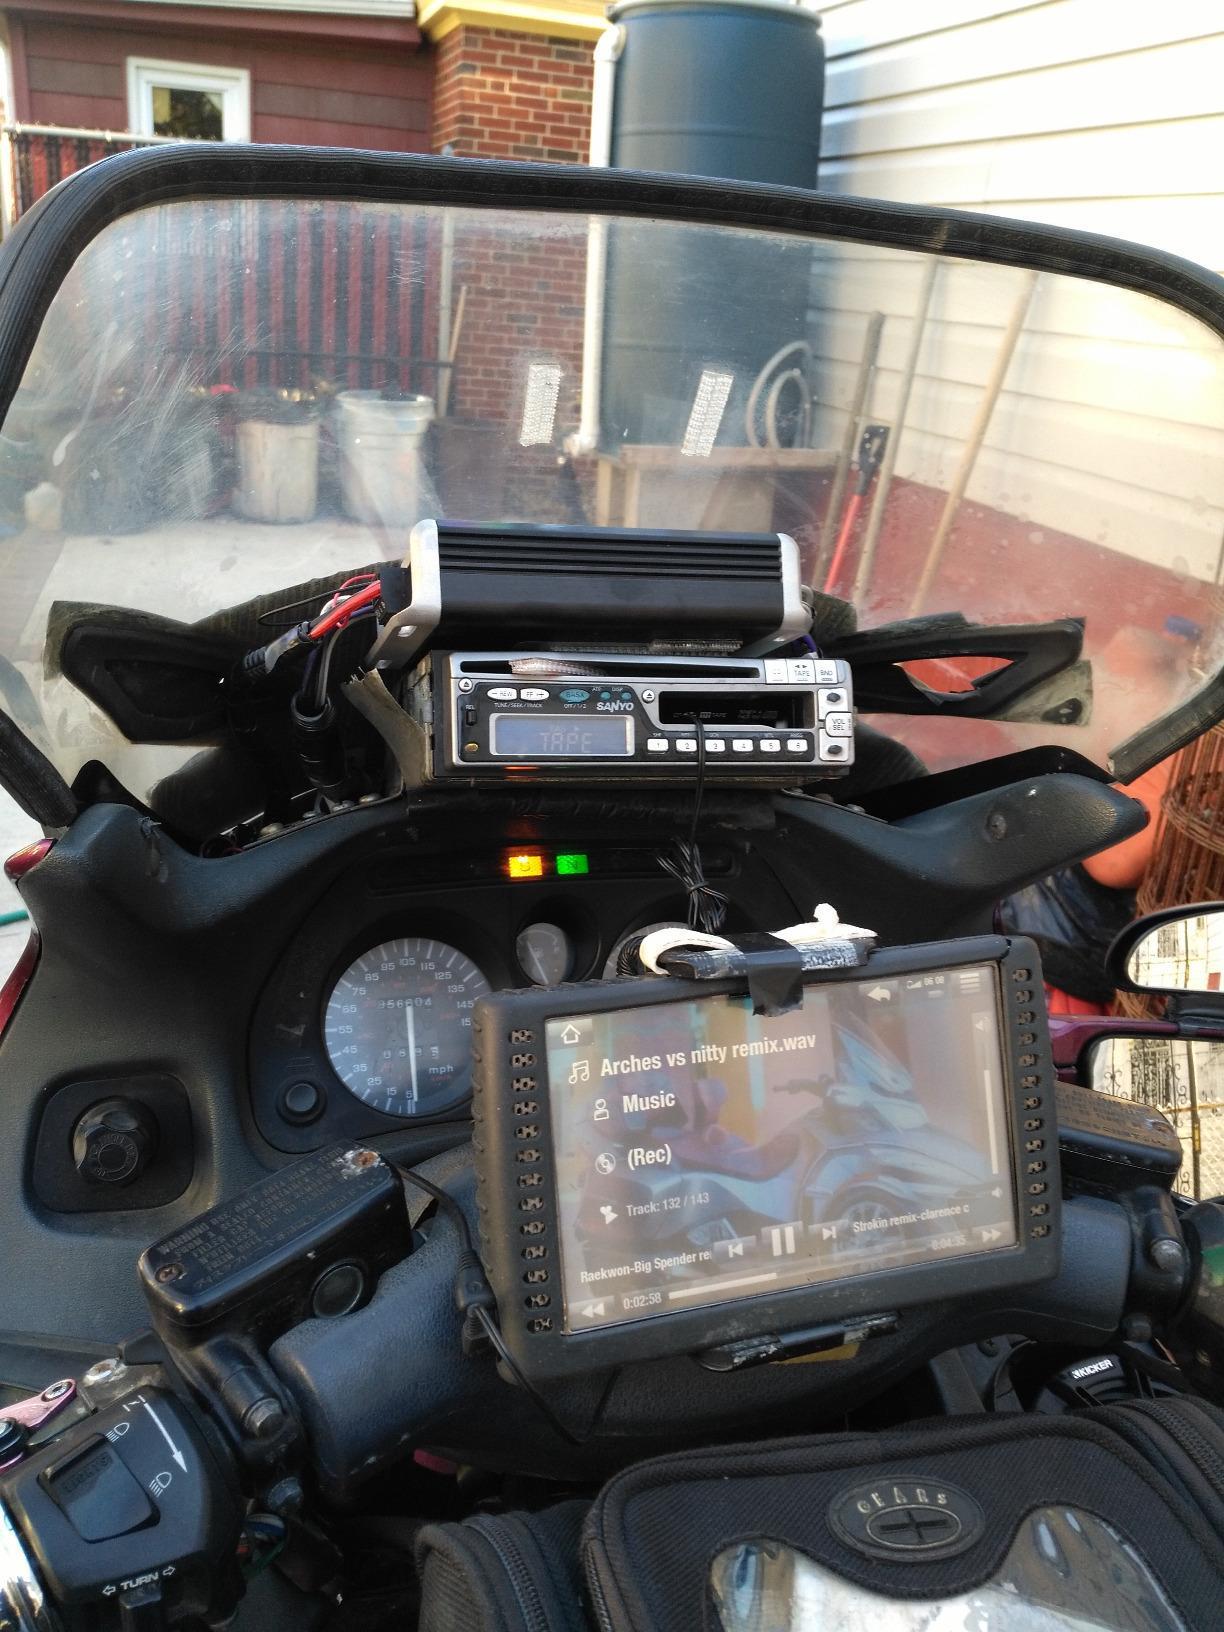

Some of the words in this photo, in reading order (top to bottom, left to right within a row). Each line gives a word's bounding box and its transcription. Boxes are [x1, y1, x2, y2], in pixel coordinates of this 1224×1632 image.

[596, 700, 634, 712] SANYO
[540, 732, 593, 753] TAPE
[380, 962, 395, 971] 95
[399, 958, 416, 966] 105
[420, 962, 435, 970] 115
[365, 972, 379, 981] 85
[435, 972, 452, 980] 125
[352, 987, 366, 996] 75
[448, 984, 465, 992] 135
[342, 1004, 357, 1013] 65
[456, 1001, 474, 1009] 145
[339, 1026, 353, 1034] 55
[342, 1046, 358, 1054] 45
[600, 1054, 662, 1076] Arches
[666, 1052, 685, 1066] vs
[691, 1044, 728, 1064] nitty
[732, 1033, 816, 1058] remix.wav
[352, 1064, 367, 1072] 35
[429, 1064, 454, 1075] mph
[368, 1077, 382, 1086] 25
[386, 1087, 397, 1096] 15
[406, 1090, 413, 1098] 5
[623, 1091, 675, 1113] Music
[627, 1144, 672, 1170] (Rec)
[626, 1203, 660, 1217] Track:
[664, 1198, 681, 1210] 132
[691, 1192, 710, 1206] 143
[853, 1217, 888, 1233] Strokin
[889, 1206, 961, 1226] remix-clarence
[580, 1259, 652, 1283] Raekwon-Big
[654, 1250, 697, 1271] Spender
[623, 1292, 662, 1310] 0:02:58
[1076, 1359, 1114, 1378] KICKER
[857, 1487, 948, 1514] GEARS
[120, 1572, 159, 1590] TURN
